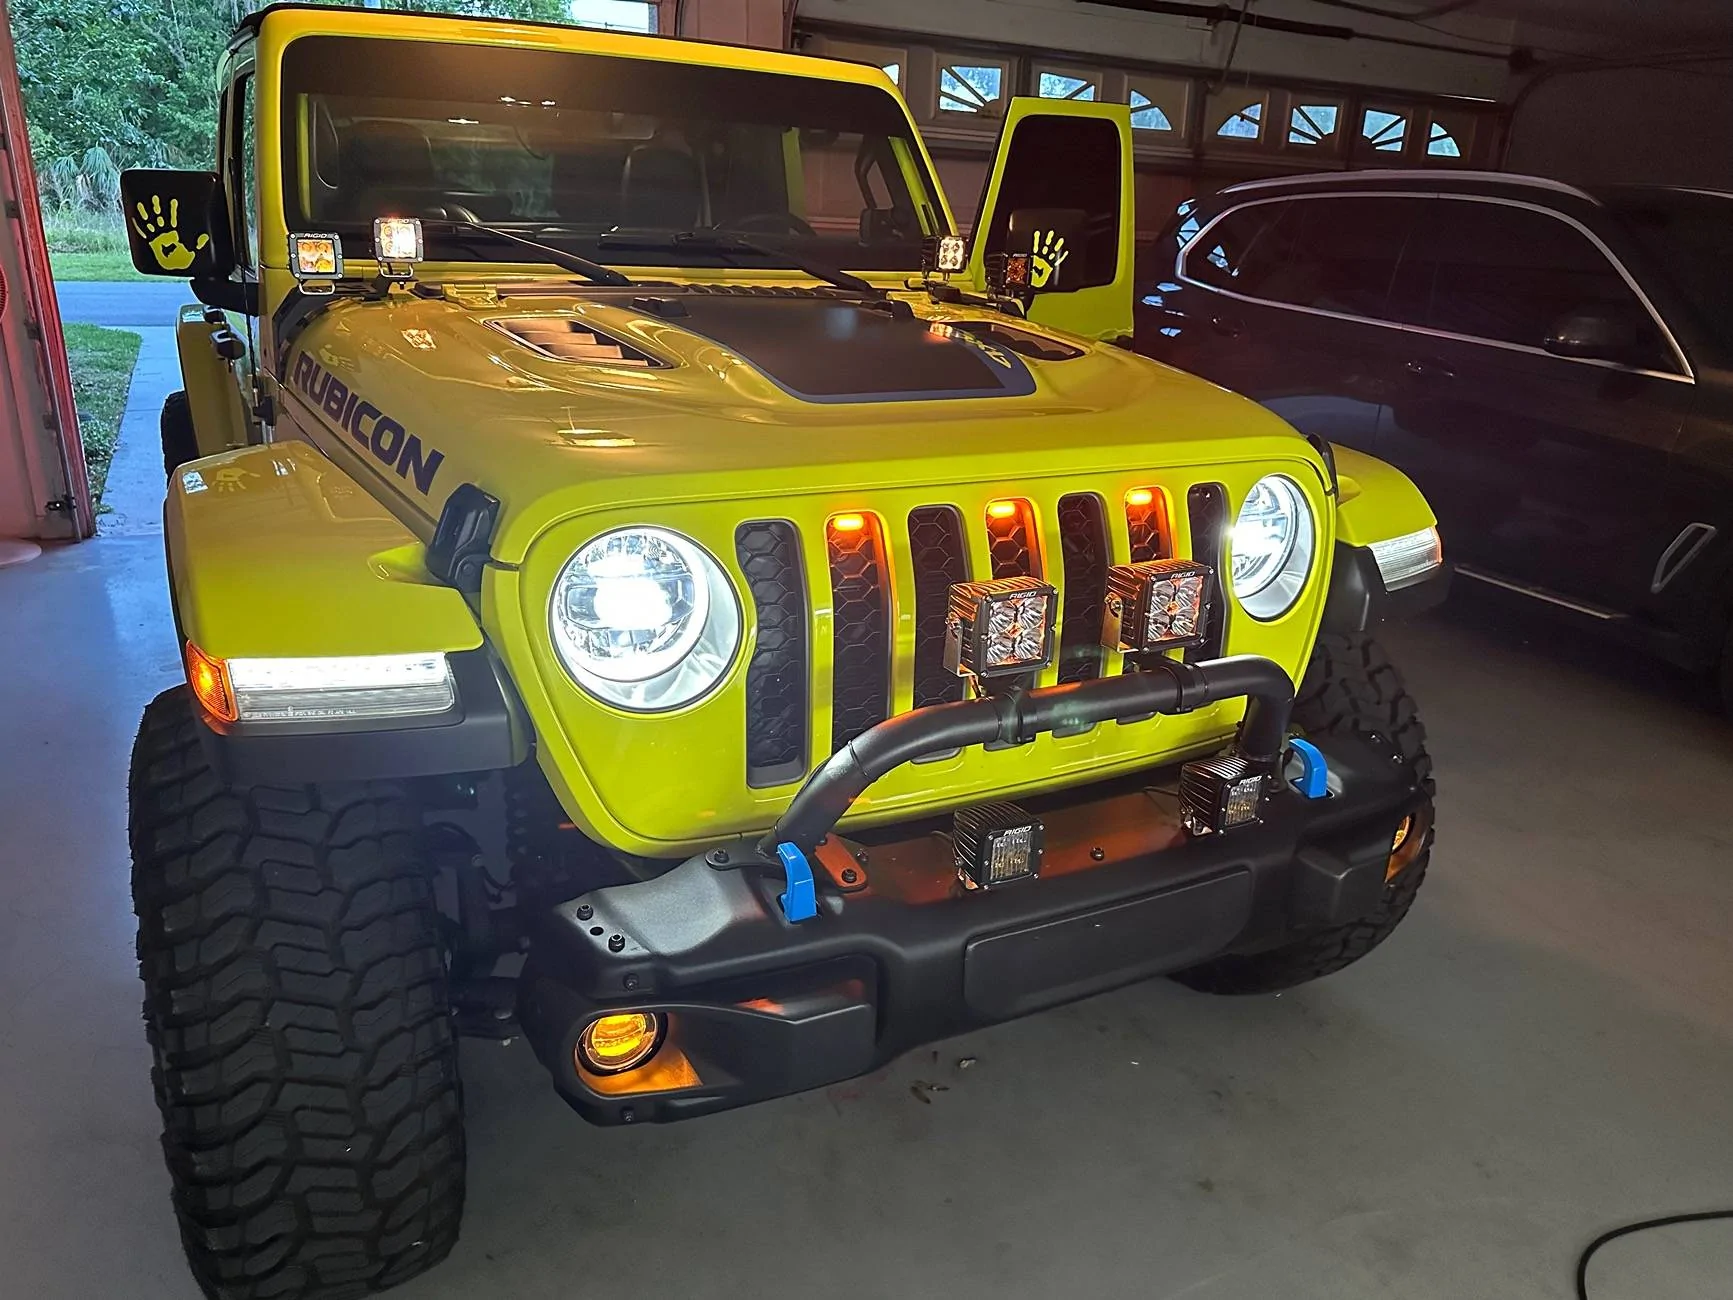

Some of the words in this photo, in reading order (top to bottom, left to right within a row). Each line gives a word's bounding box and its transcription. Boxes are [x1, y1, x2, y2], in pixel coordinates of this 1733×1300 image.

[293, 350, 445, 496] RUBICON
[1170, 571, 1196, 579] RIGID
[1009, 591, 1037, 600] RIGID
[1238, 775, 1263, 786] RIGID
[1003, 825, 1032, 837] RIGID
